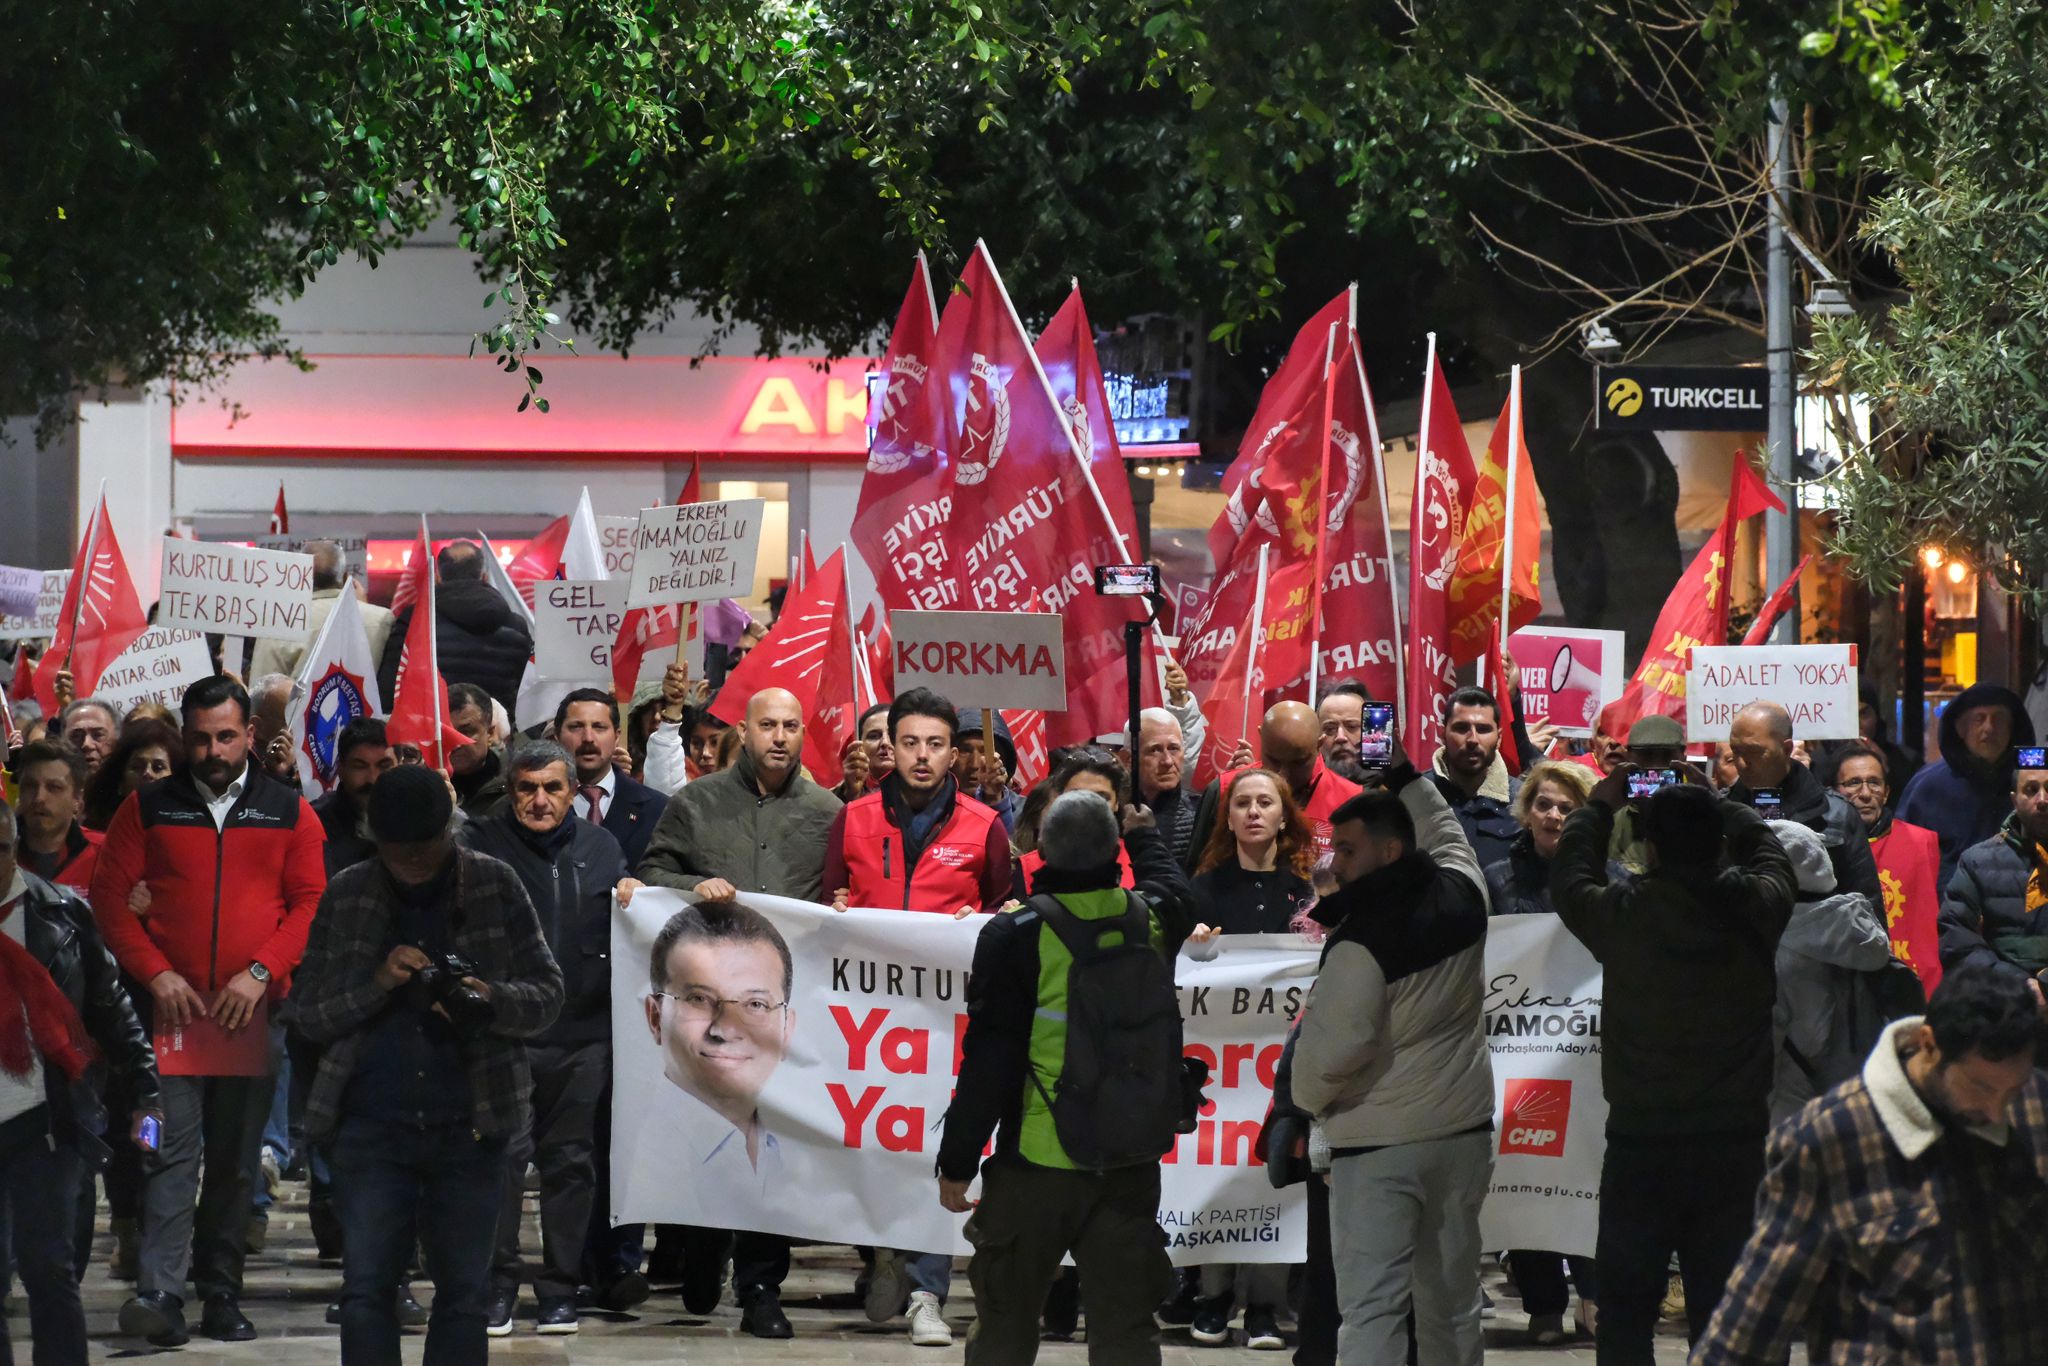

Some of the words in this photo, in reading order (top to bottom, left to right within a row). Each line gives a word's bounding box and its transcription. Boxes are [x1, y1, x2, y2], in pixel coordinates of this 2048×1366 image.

[1650, 387, 1763, 409] TURKCELL
[677, 504, 727, 521] EKREM
[640, 520, 747, 550] İMAMOĞLU
[670, 548, 728, 567] YALNIZ
[168, 552, 268, 588] KURTULUŞ
[275, 562, 313, 590] YOK
[165, 591, 208, 620] TEK
[215, 595, 307, 630] BAŞINA
[897, 640, 1057, 677] KORKMA
[1794, 663, 1848, 686] YOKSA
[1521, 691, 1549, 716] İYE!
[1232, 986, 1302, 1021] BAŞ
[828, 1005, 930, 1075] Ya
[1555, 1043, 1588, 1057] Aday
[825, 1083, 925, 1153] Ya
[1508, 1127, 1557, 1147] CHP
[1210, 1203, 1281, 1224] PARTİSİ
